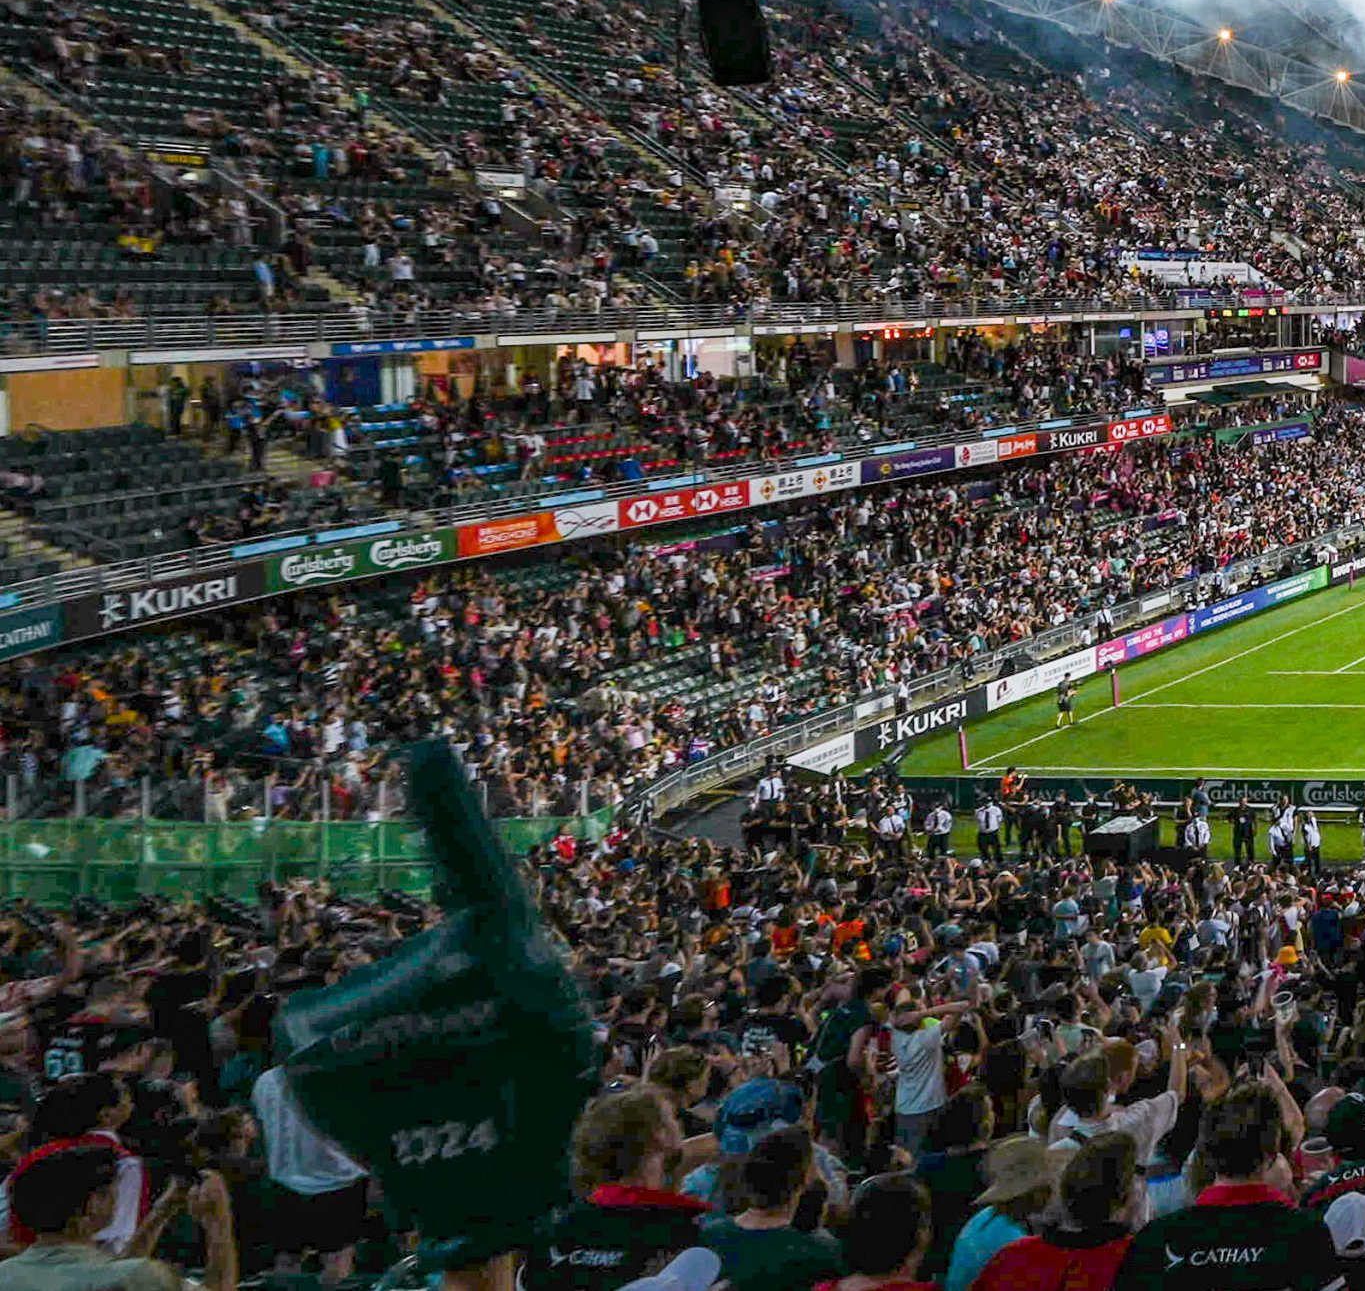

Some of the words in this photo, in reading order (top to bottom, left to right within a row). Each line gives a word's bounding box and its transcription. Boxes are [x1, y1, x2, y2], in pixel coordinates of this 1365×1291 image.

[1060, 431, 1098, 447] KUKRI
[280, 551, 355, 585] Carlsberg
[370, 537, 442, 568] Carlsberg
[130, 576, 238, 620] KUKRI
[896, 700, 967, 741] KUKRI
[569, 1249, 625, 1267] CATHAY
[1189, 1247, 1264, 1266] CATHAY
